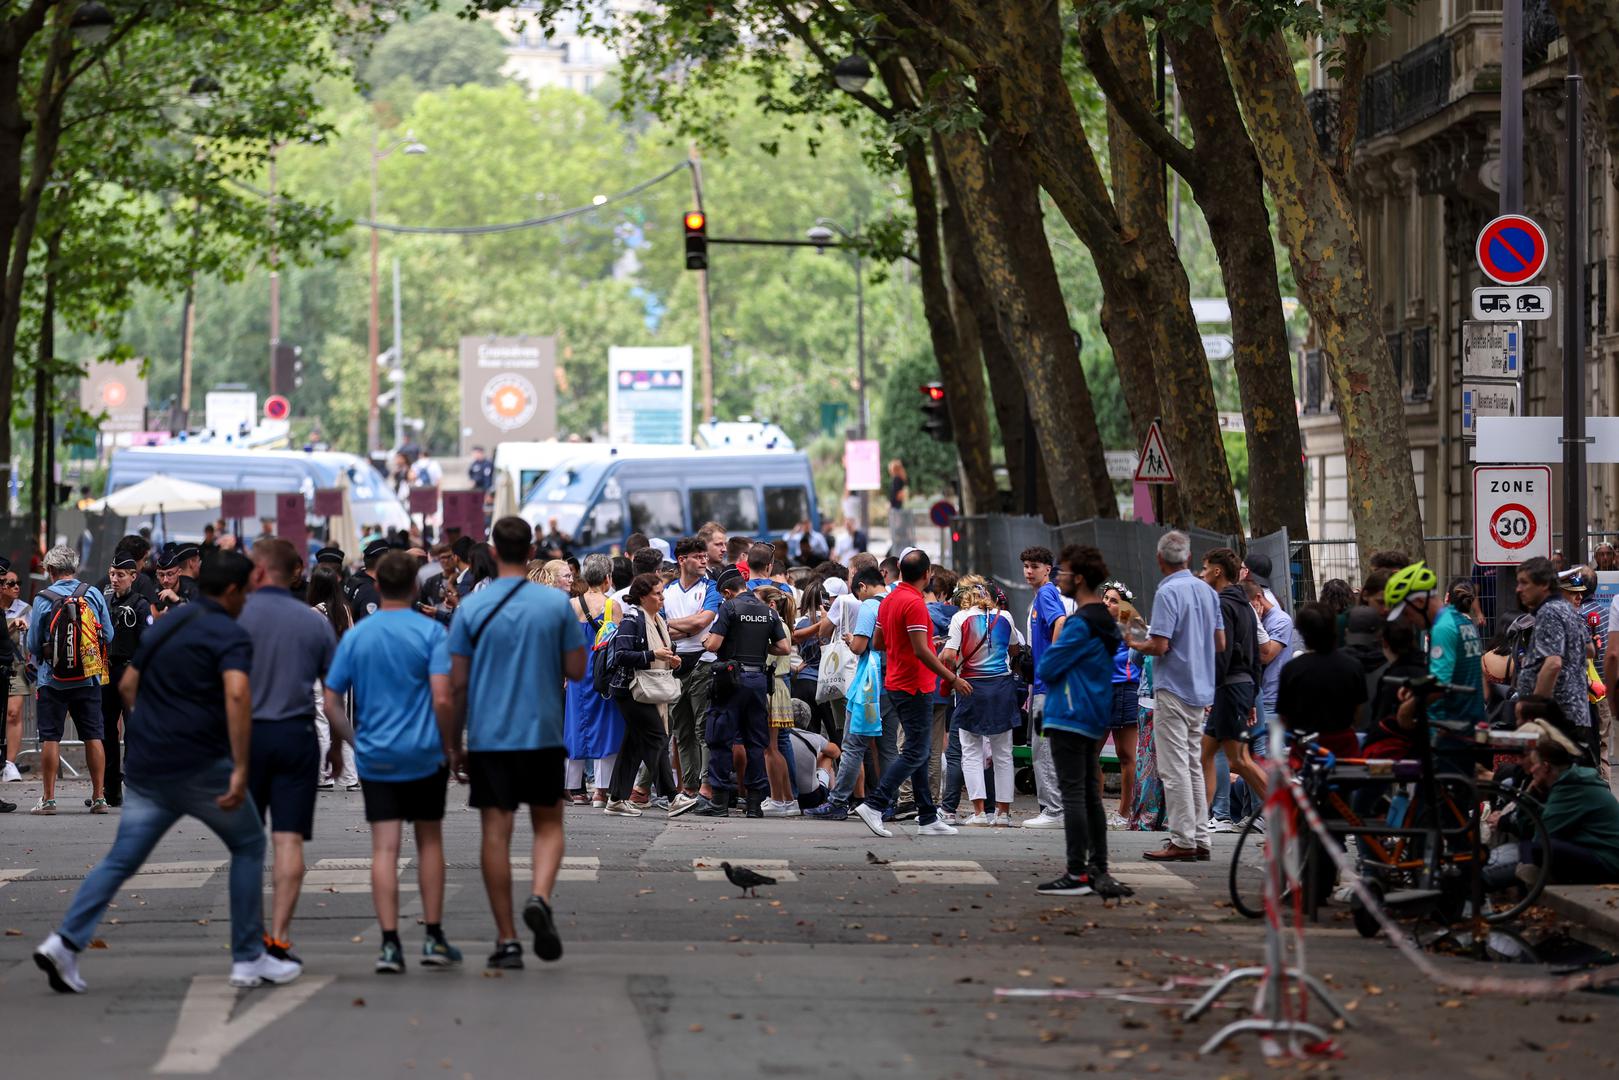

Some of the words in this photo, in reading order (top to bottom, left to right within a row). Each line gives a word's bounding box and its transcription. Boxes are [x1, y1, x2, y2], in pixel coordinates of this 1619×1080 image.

[1491, 481, 1534, 493] ZONE
[1499, 517, 1527, 536] 30
[740, 614, 768, 623] POLICE
[830, 676, 846, 684] 2024
